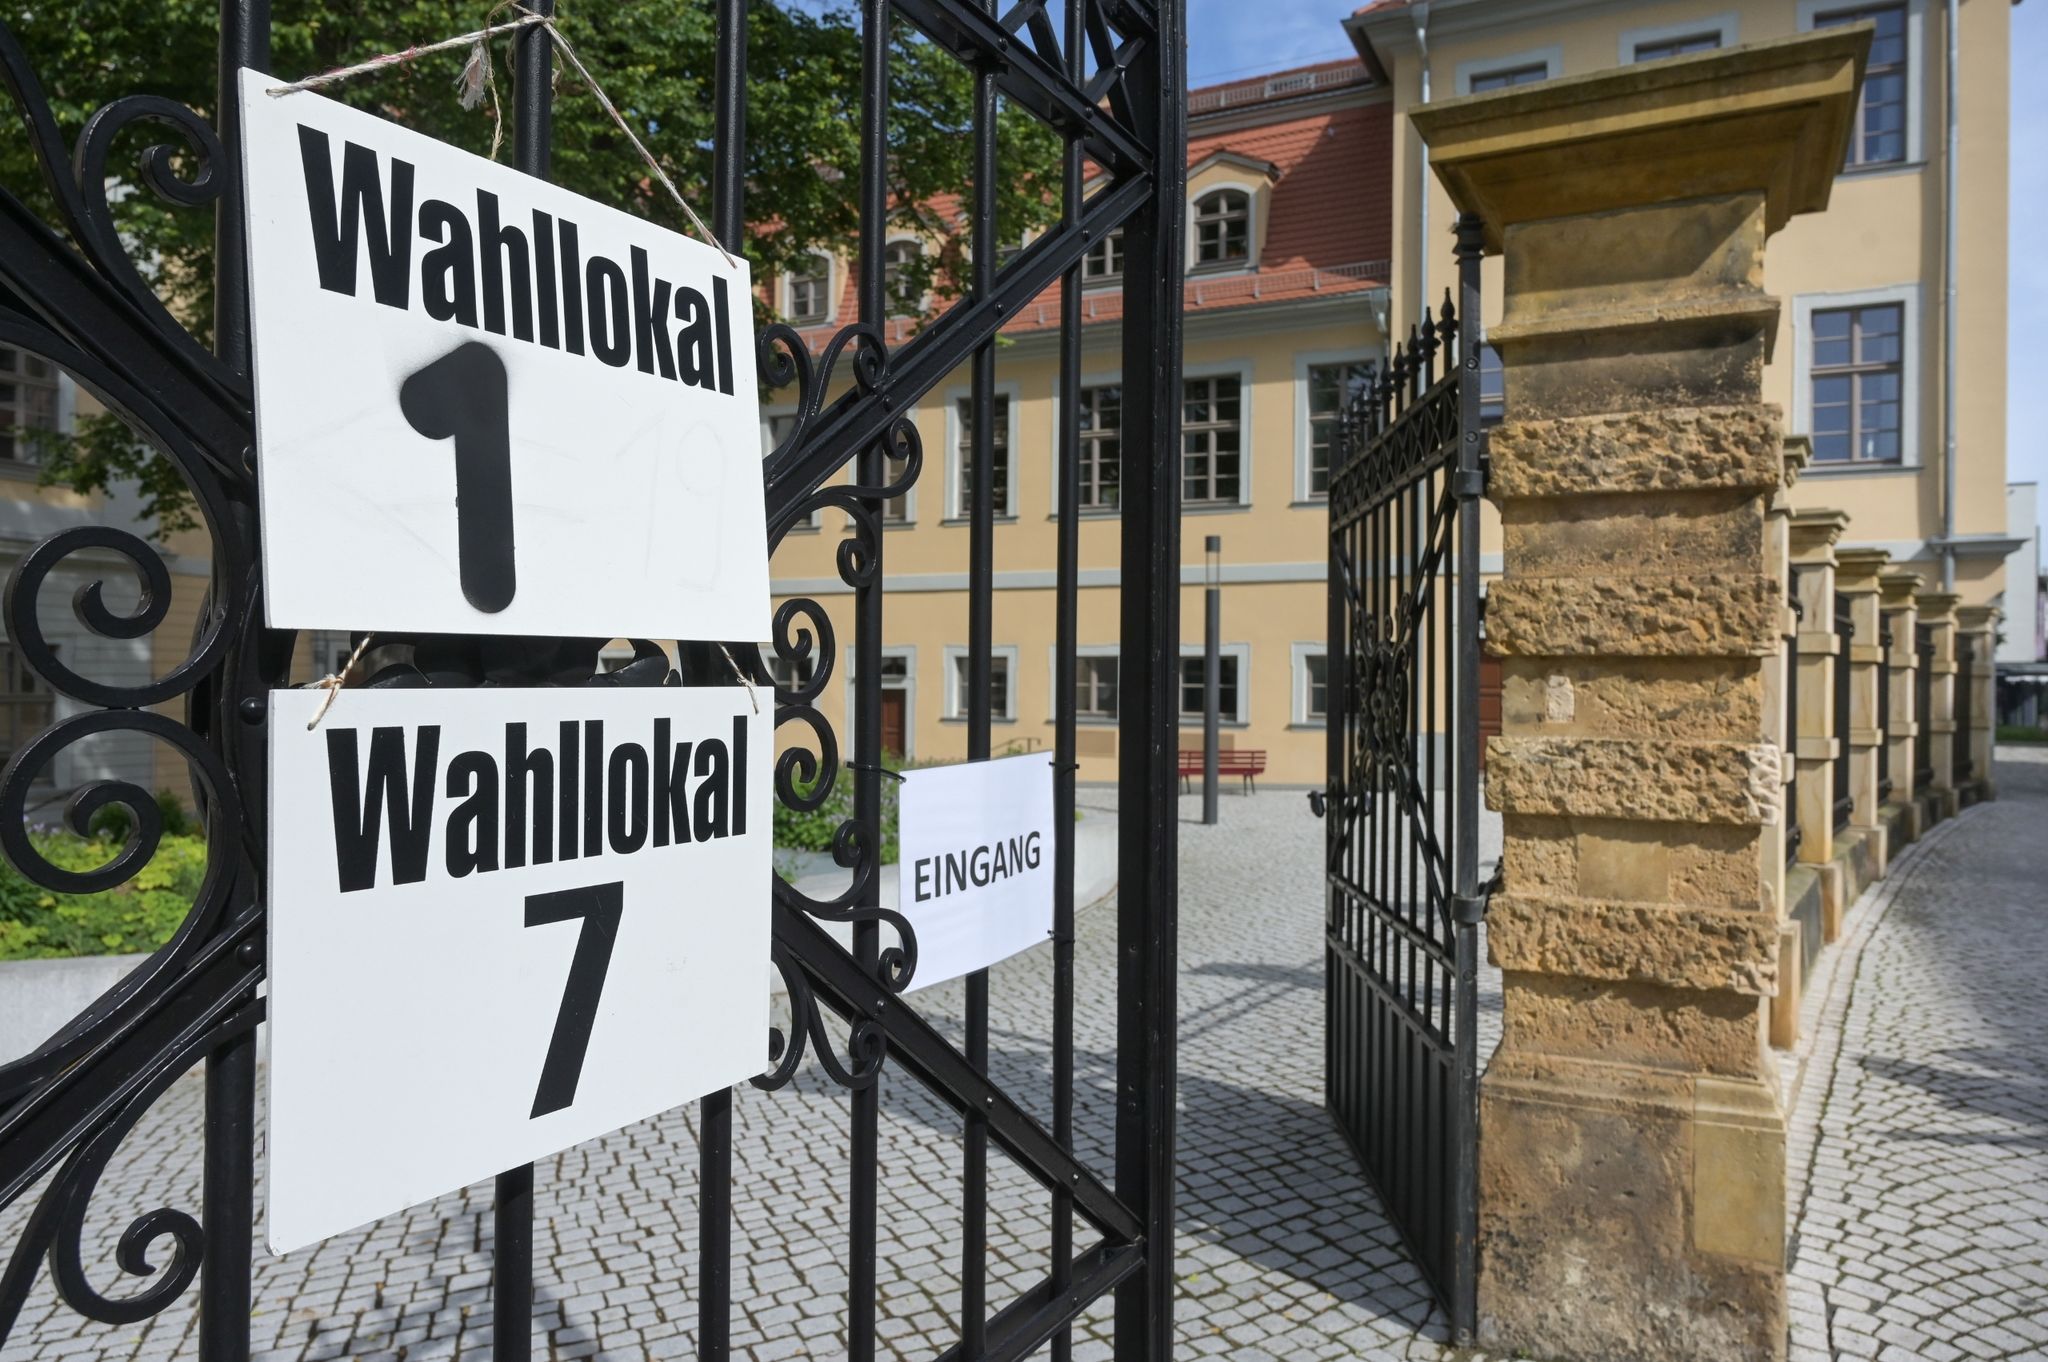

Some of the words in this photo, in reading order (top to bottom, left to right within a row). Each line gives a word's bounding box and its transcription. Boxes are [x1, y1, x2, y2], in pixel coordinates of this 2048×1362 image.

[297, 123, 735, 396] Wahllokal
[399, 341, 516, 614] 1
[326, 716, 747, 894] Wahllokal
[916, 830, 1041, 903] EINGANG
[524, 881, 624, 1120] 7
